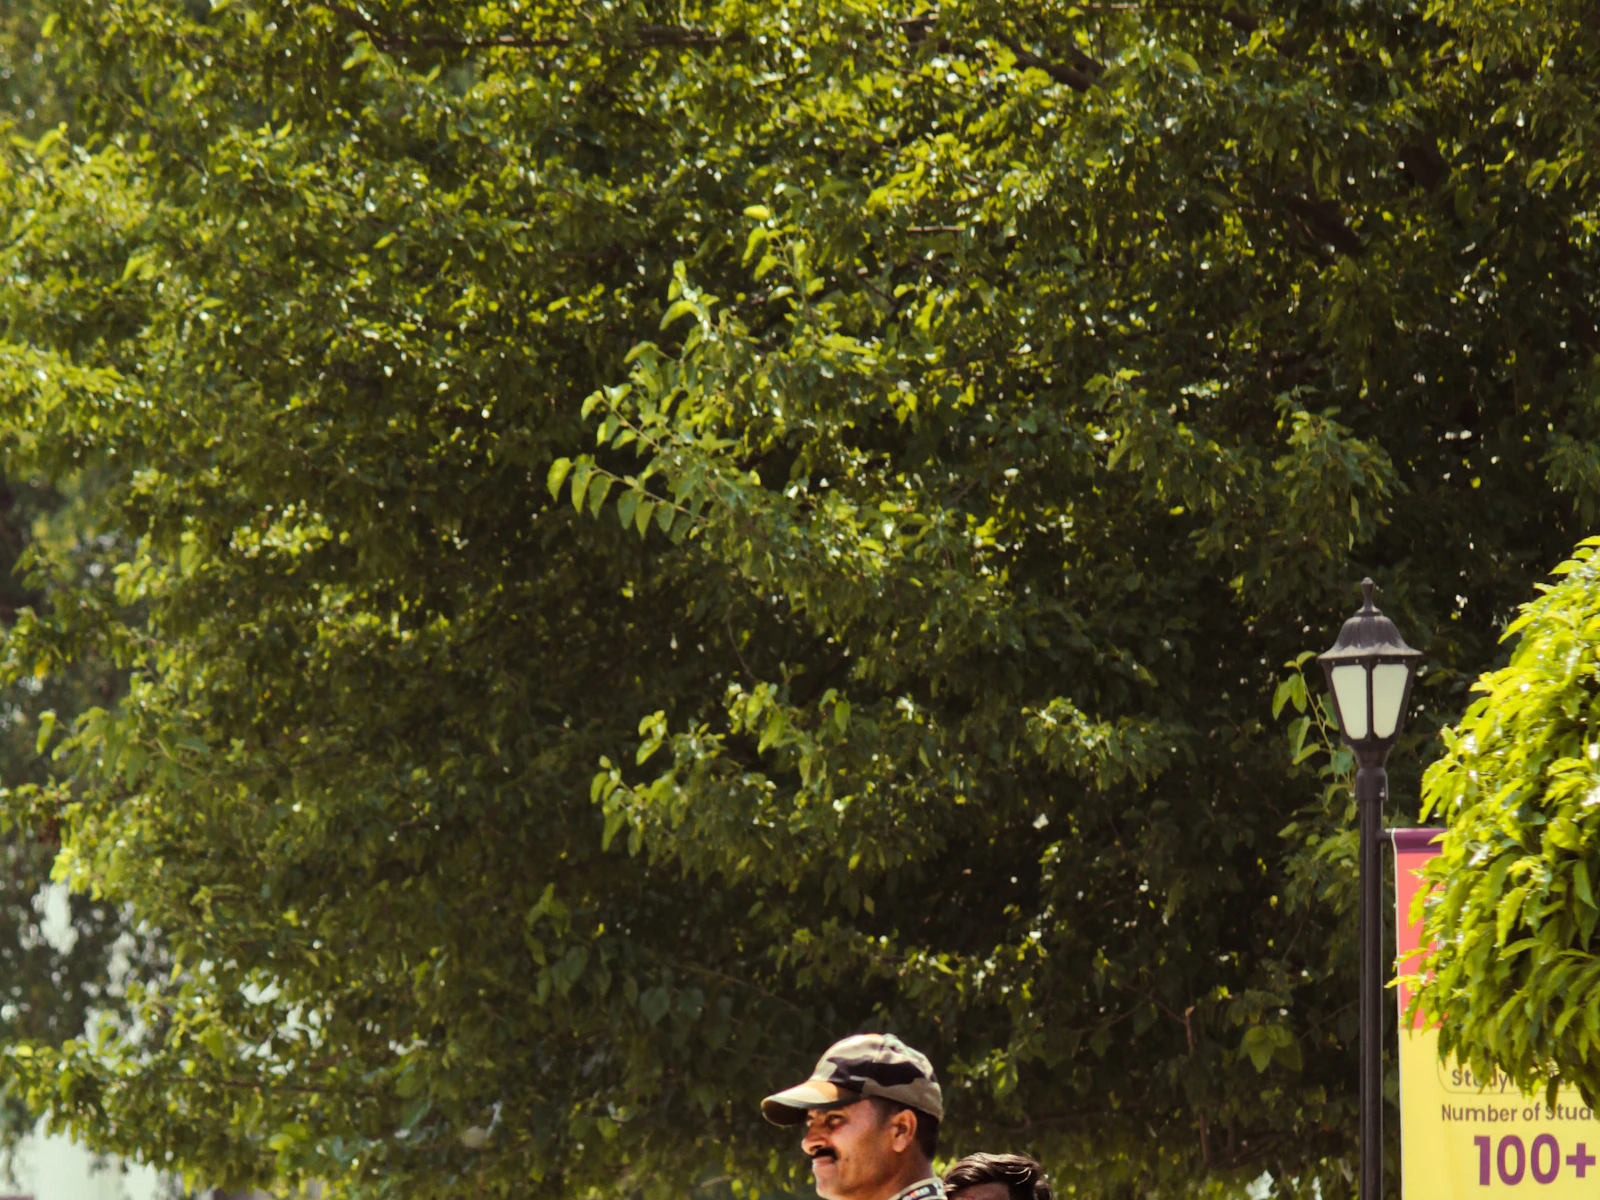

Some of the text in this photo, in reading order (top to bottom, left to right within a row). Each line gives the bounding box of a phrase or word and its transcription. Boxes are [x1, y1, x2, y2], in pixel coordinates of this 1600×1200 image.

[1441, 1103, 1517, 1122] Number
[1522, 1102, 1541, 1121] of
[1473, 1133, 1597, 1187] 100+
